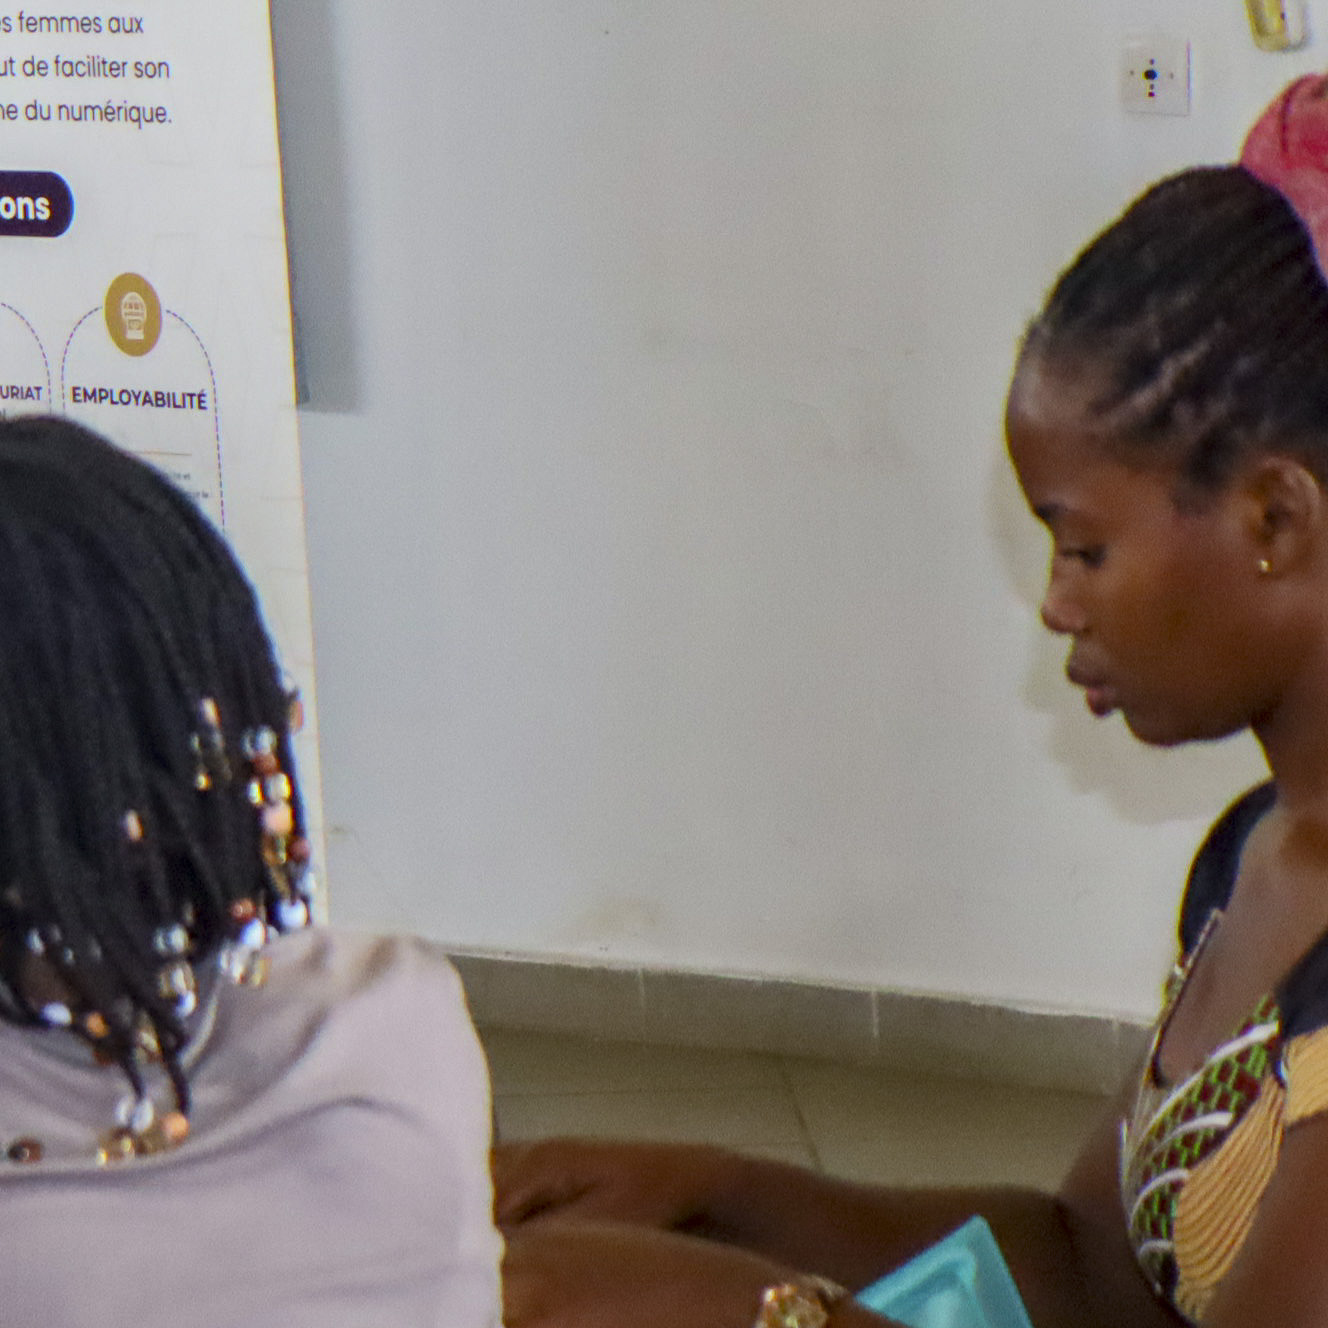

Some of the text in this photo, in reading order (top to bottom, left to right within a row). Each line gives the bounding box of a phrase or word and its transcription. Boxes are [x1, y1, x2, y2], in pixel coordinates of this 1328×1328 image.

[17, 10, 103, 34] femmes
[108, 15, 144, 34] aux
[22, 55, 49, 77] de
[53, 54, 129, 78] faciliter
[133, 58, 170, 79] son
[24, 97, 52, 120] du
[57, 98, 173, 129] numérique.
[71, 385, 208, 411] EMPLOYABILITÉ
